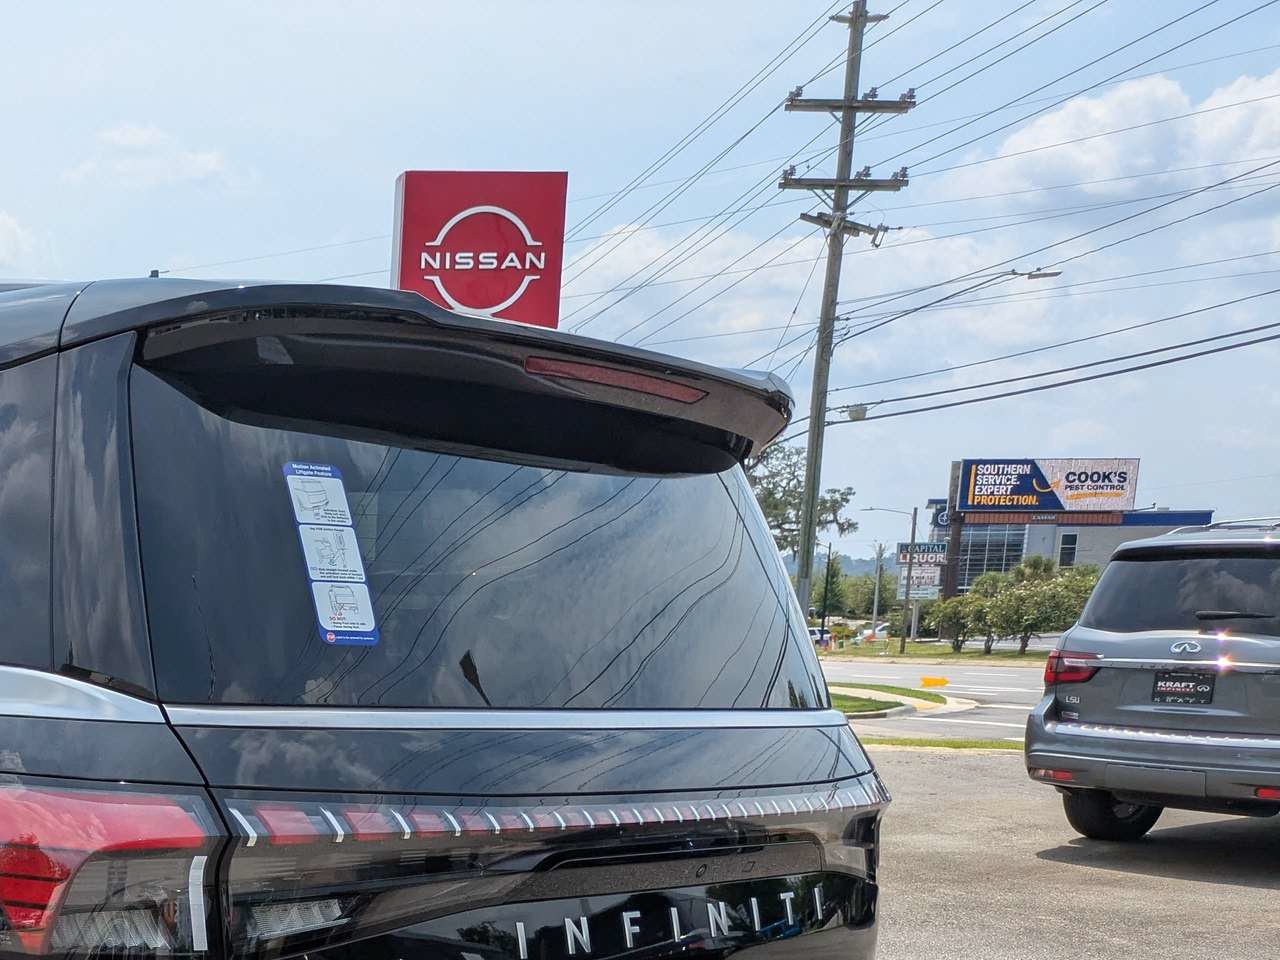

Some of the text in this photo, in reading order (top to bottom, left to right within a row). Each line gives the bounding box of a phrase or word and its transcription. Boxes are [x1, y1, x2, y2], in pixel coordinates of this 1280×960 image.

[421, 252, 545, 269] NISSAN
[976, 464, 1032, 475] SOUTHERN
[976, 474, 1020, 485] SERVICE.
[1065, 471, 1128, 484] COOK'S
[974, 485, 1014, 495] EXPERT
[973, 495, 1039, 506] PROTECTION.
[907, 544, 945, 553] CAPITAL
[515, 887, 823, 960] INFINITI
